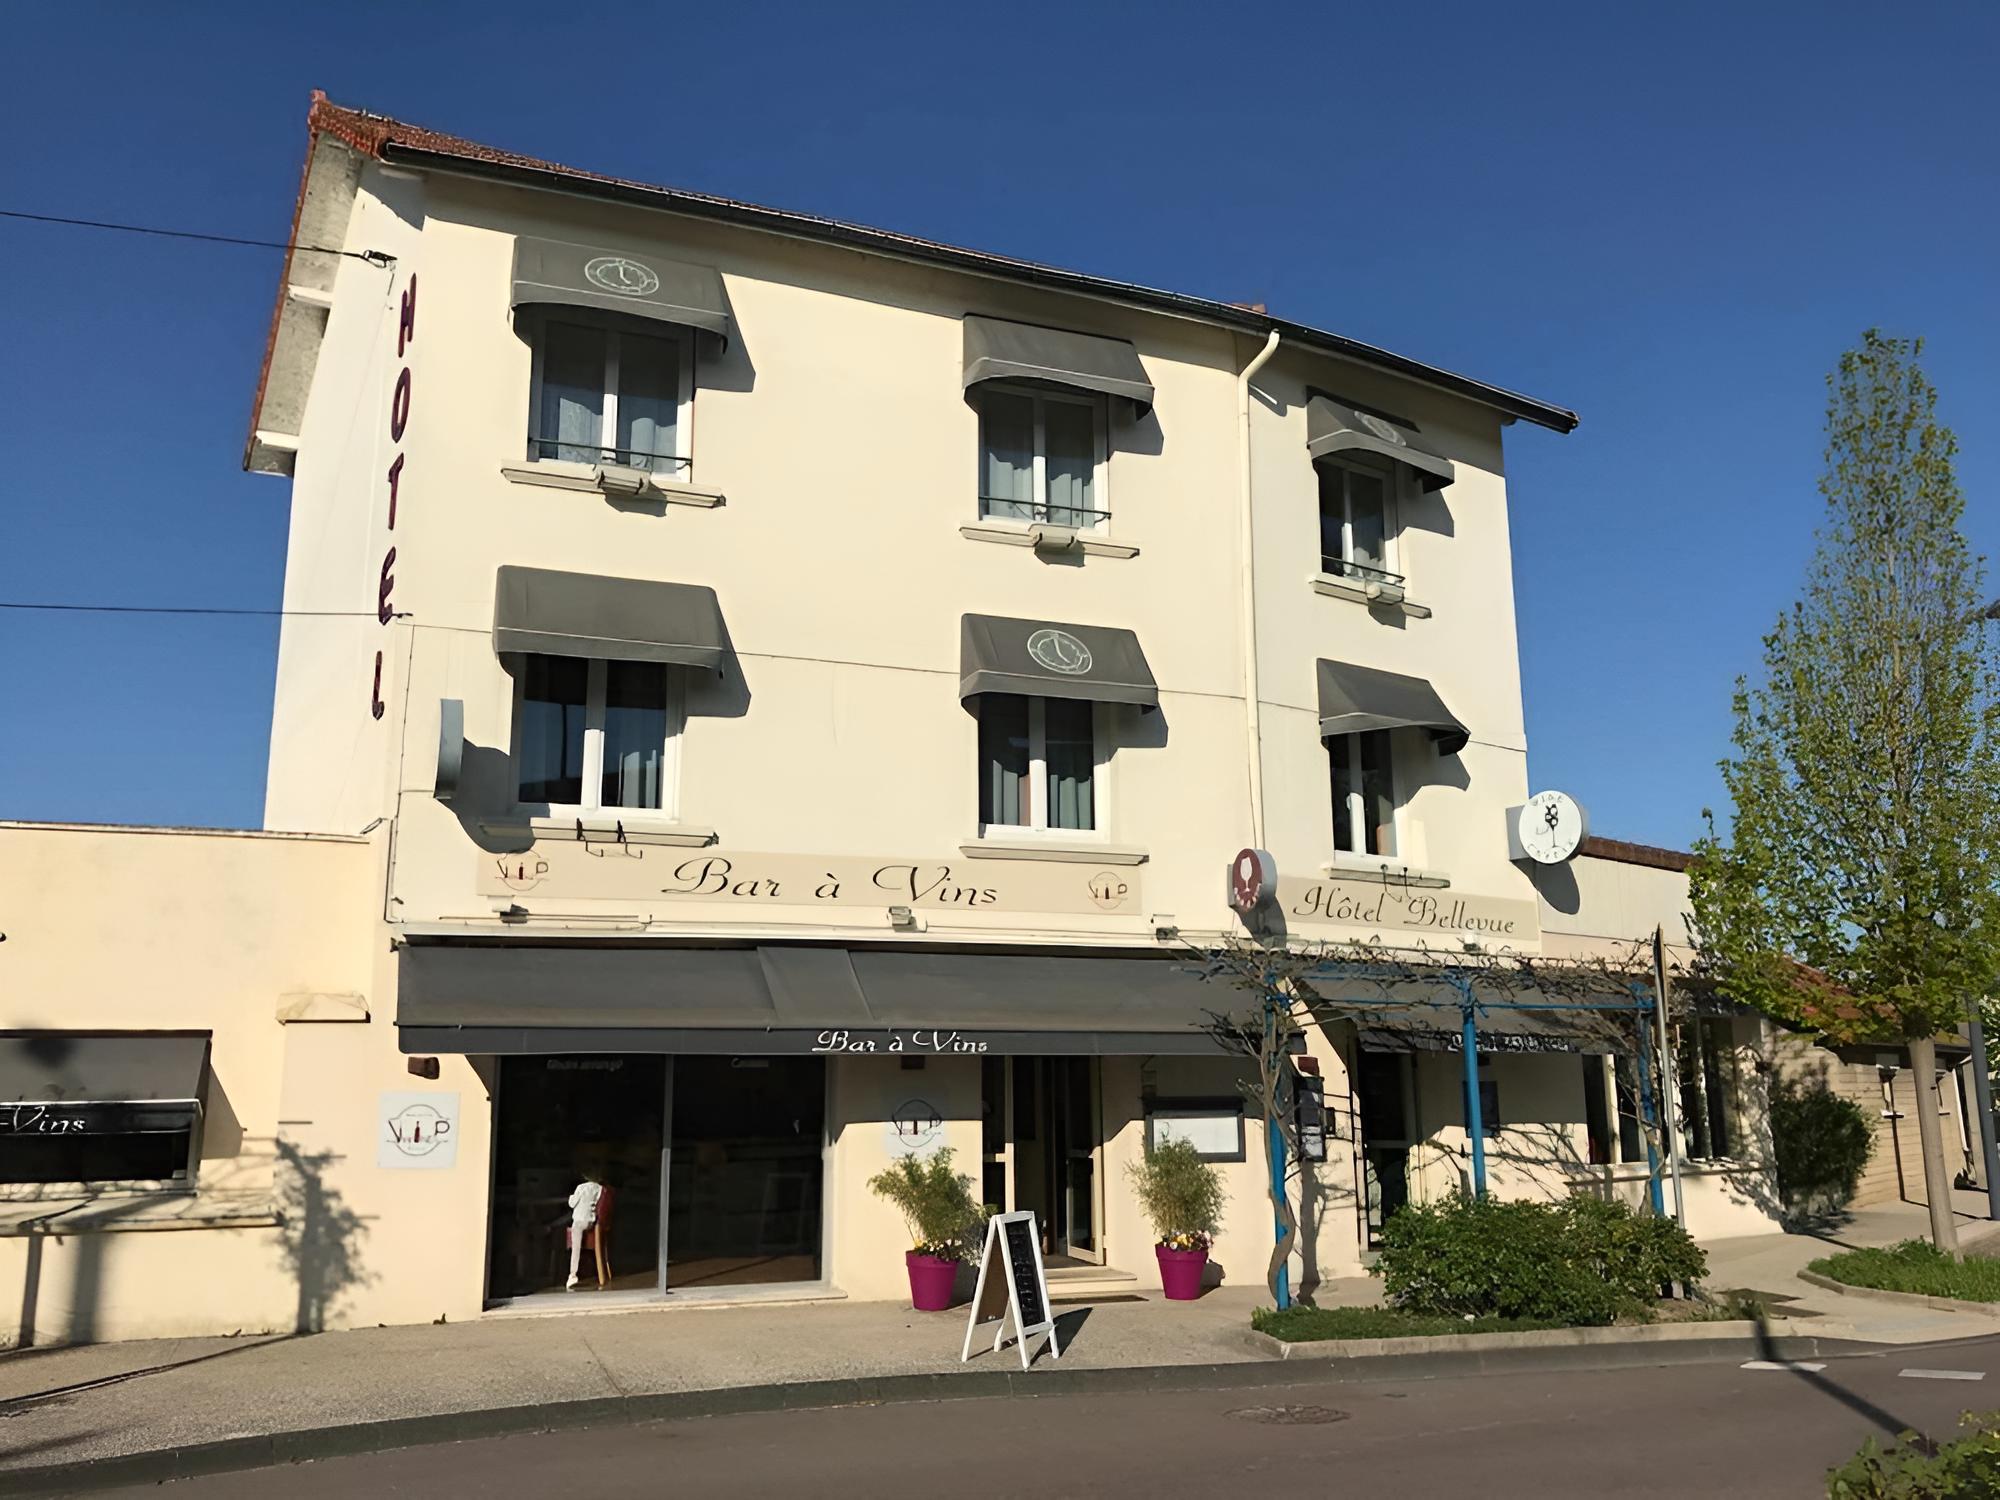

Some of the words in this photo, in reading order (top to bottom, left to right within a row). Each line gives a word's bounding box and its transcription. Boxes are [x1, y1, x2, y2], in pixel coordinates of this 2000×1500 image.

[372, 272, 417, 721] HOTEL
[660, 857, 781, 897] Bar
[815, 872, 841, 899] à
[872, 865, 998, 906] Vins
[1292, 886, 1386, 922] Hôtel
[1403, 894, 1515, 933] Bellevue
[811, 1030, 876, 1052] Bar
[888, 1036, 904, 1052] à
[912, 1031, 988, 1052] Vins
[0, 1105, 86, 1135] Vins
